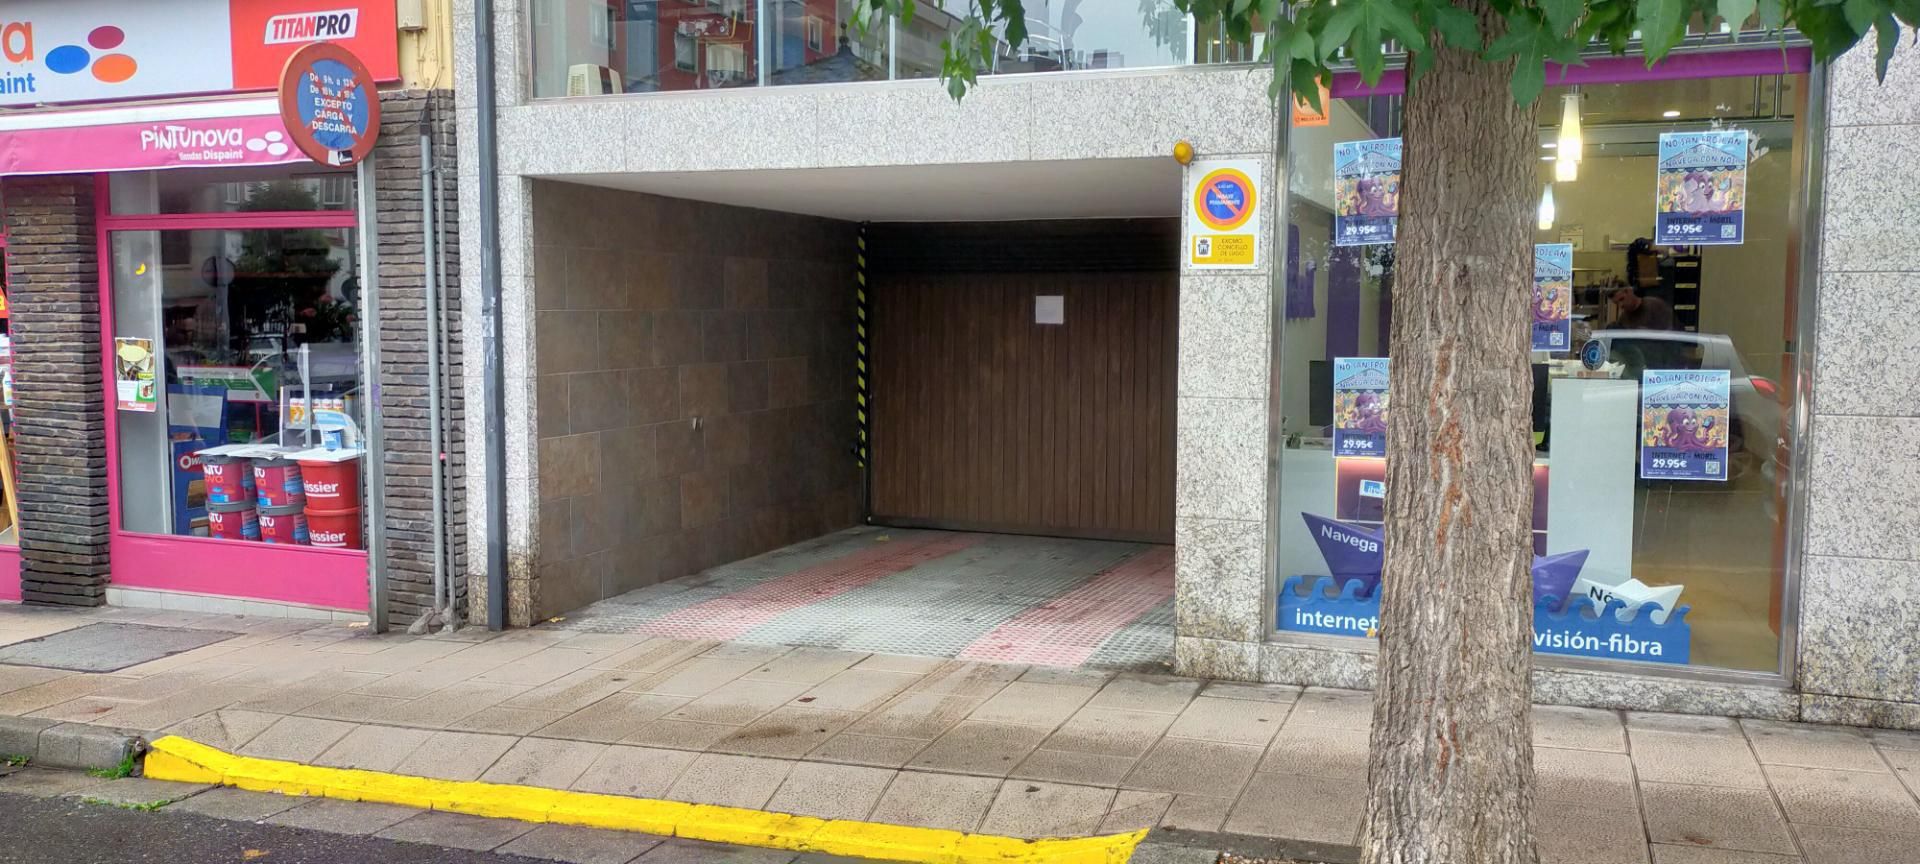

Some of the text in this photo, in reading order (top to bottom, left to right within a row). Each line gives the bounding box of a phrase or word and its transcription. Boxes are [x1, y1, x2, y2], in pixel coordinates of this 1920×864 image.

[273, 13, 351, 40] TITANPRO
[314, 97, 352, 111] EXCEPTO
[314, 109, 353, 123] CARGA Y
[1665, 139, 1678, 148] NO
[203, 148, 243, 162] Dispaint
[1339, 149, 1351, 157] NO
[1345, 225, 1377, 237] 29.95€
[1667, 224, 1702, 235] 29.95€
[1339, 362, 1351, 371] NO
[1648, 376, 1661, 385] NO
[1343, 440, 1374, 449] 29.95€
[1652, 459, 1688, 469] 29.95€
[1321, 524, 1379, 553] Navega
[1296, 607, 1379, 632] internet
[1533, 628, 1664, 657] visión-fibra
